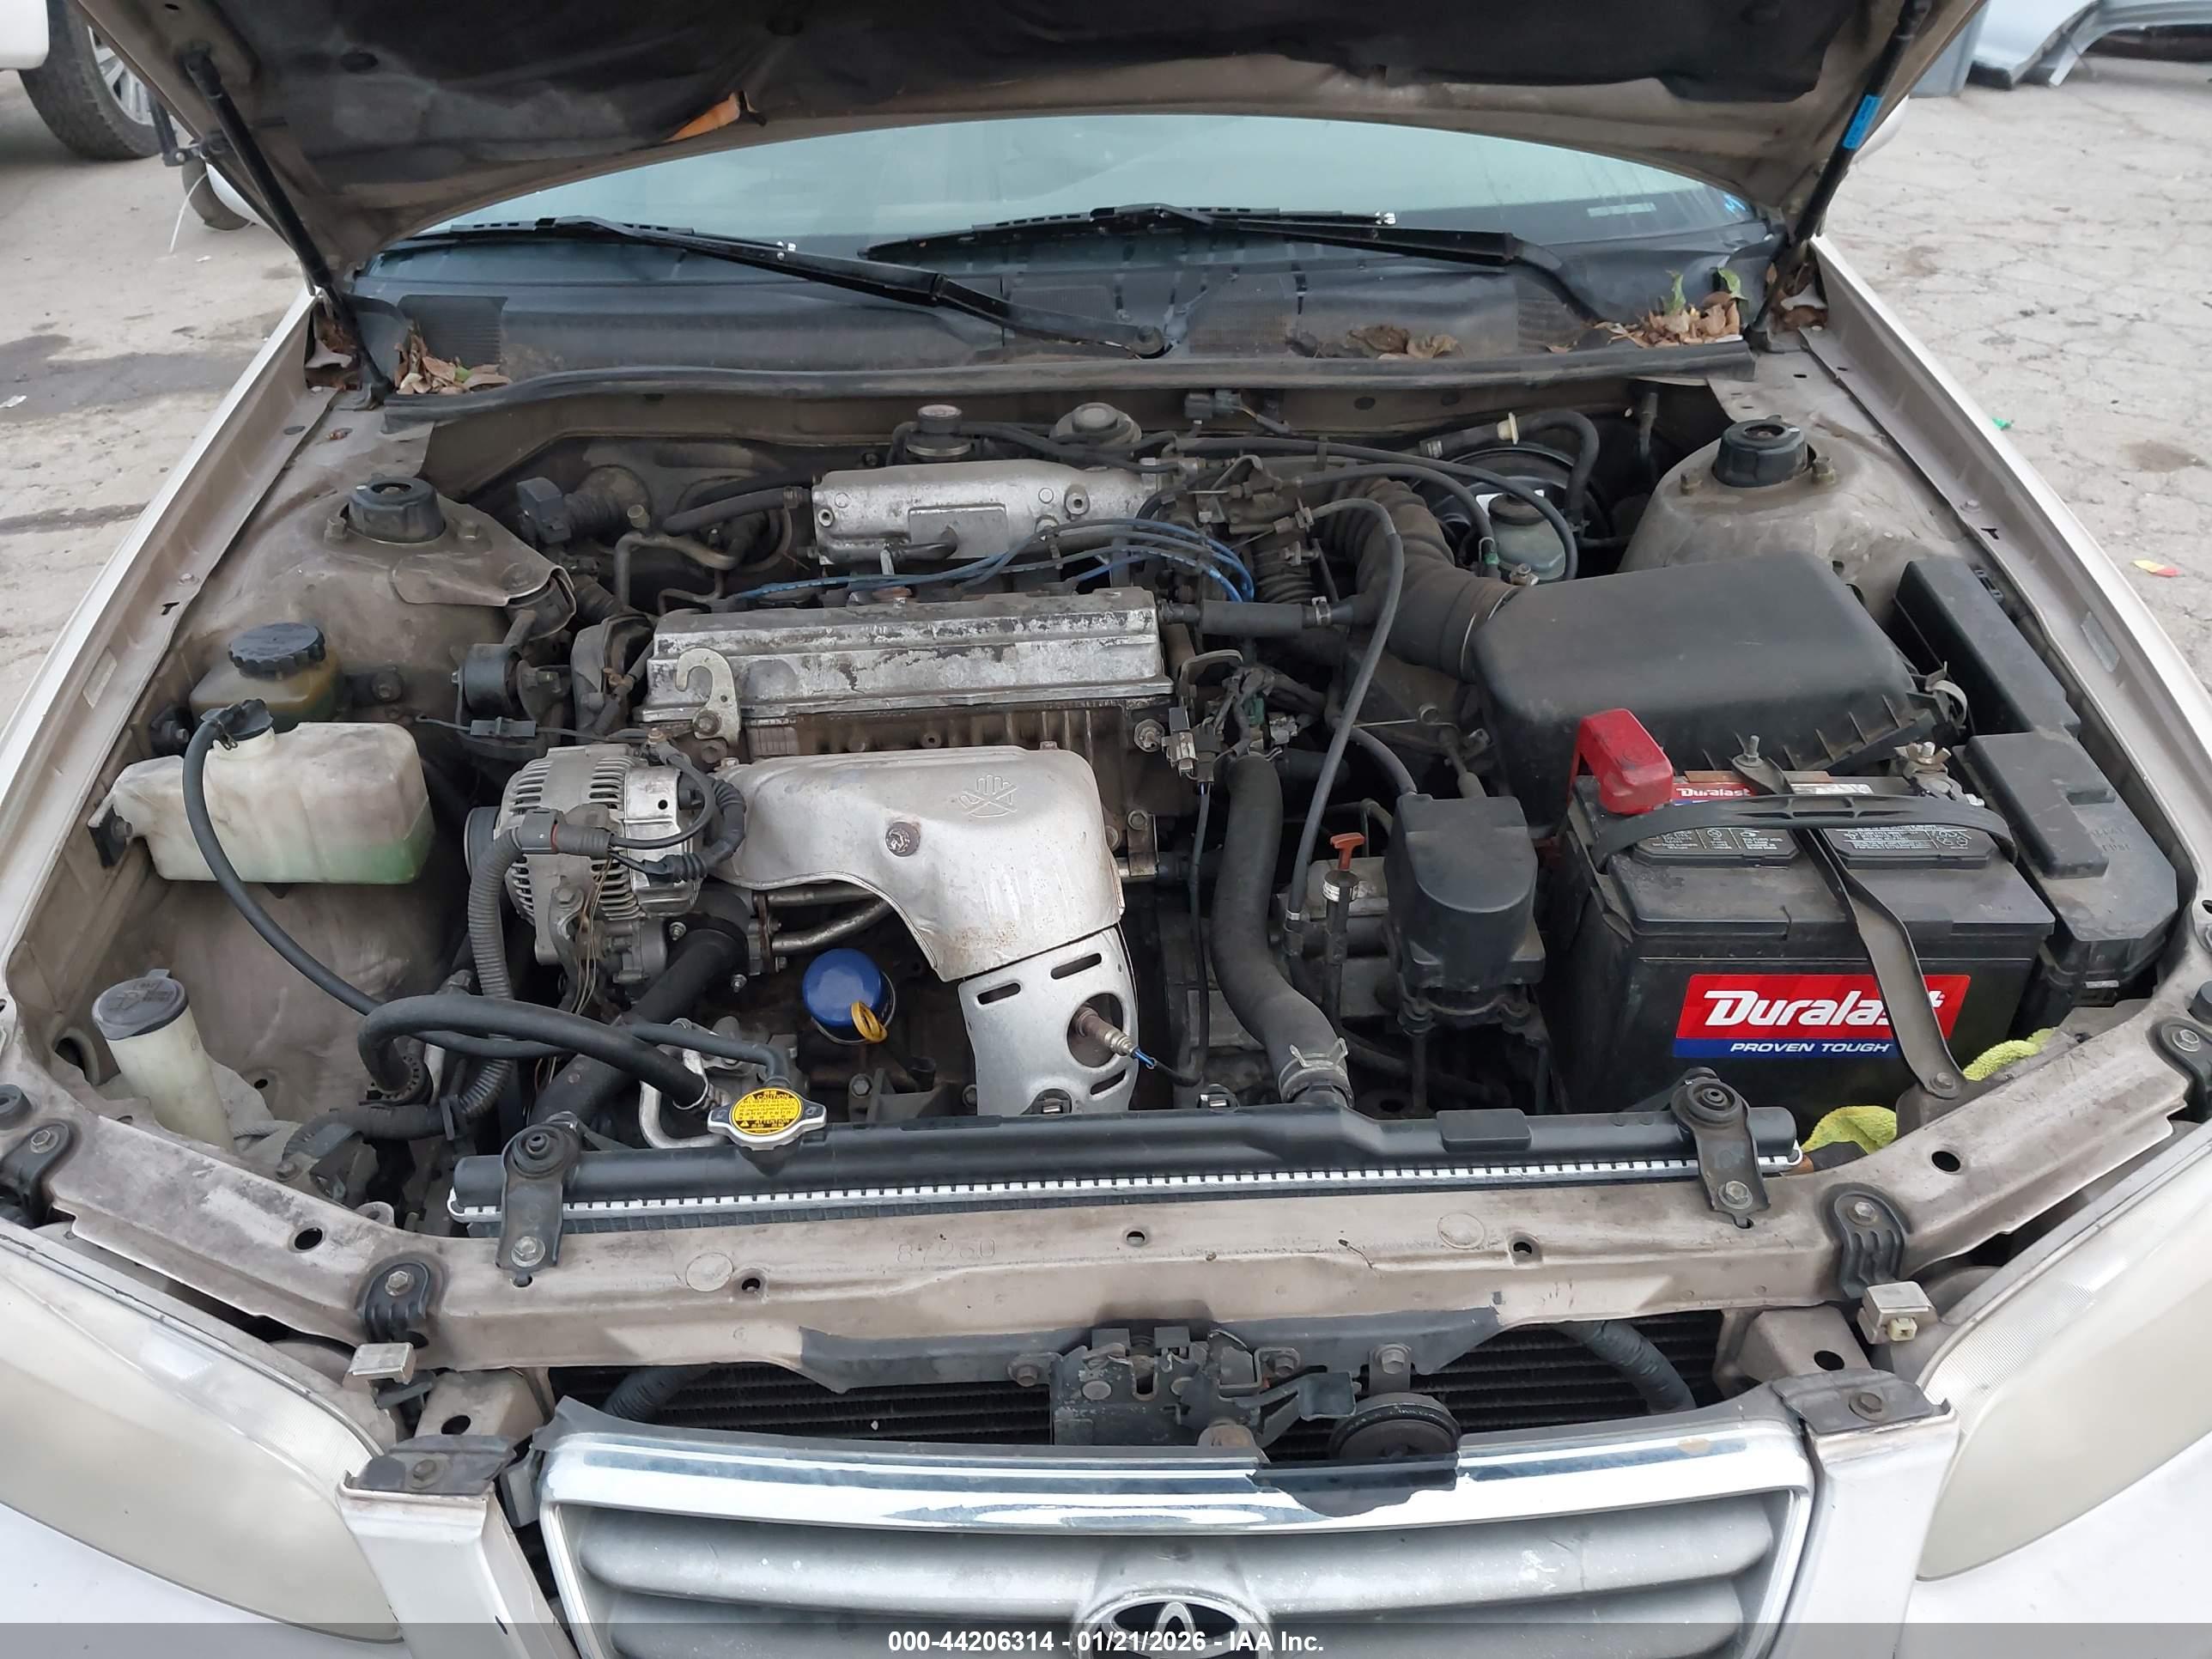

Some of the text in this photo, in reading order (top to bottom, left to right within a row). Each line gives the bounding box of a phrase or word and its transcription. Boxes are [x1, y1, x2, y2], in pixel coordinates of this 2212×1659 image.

[1676, 787, 1751, 797] Duralast
[1730, 1042, 1890, 1052] PROVEN TOUGH
